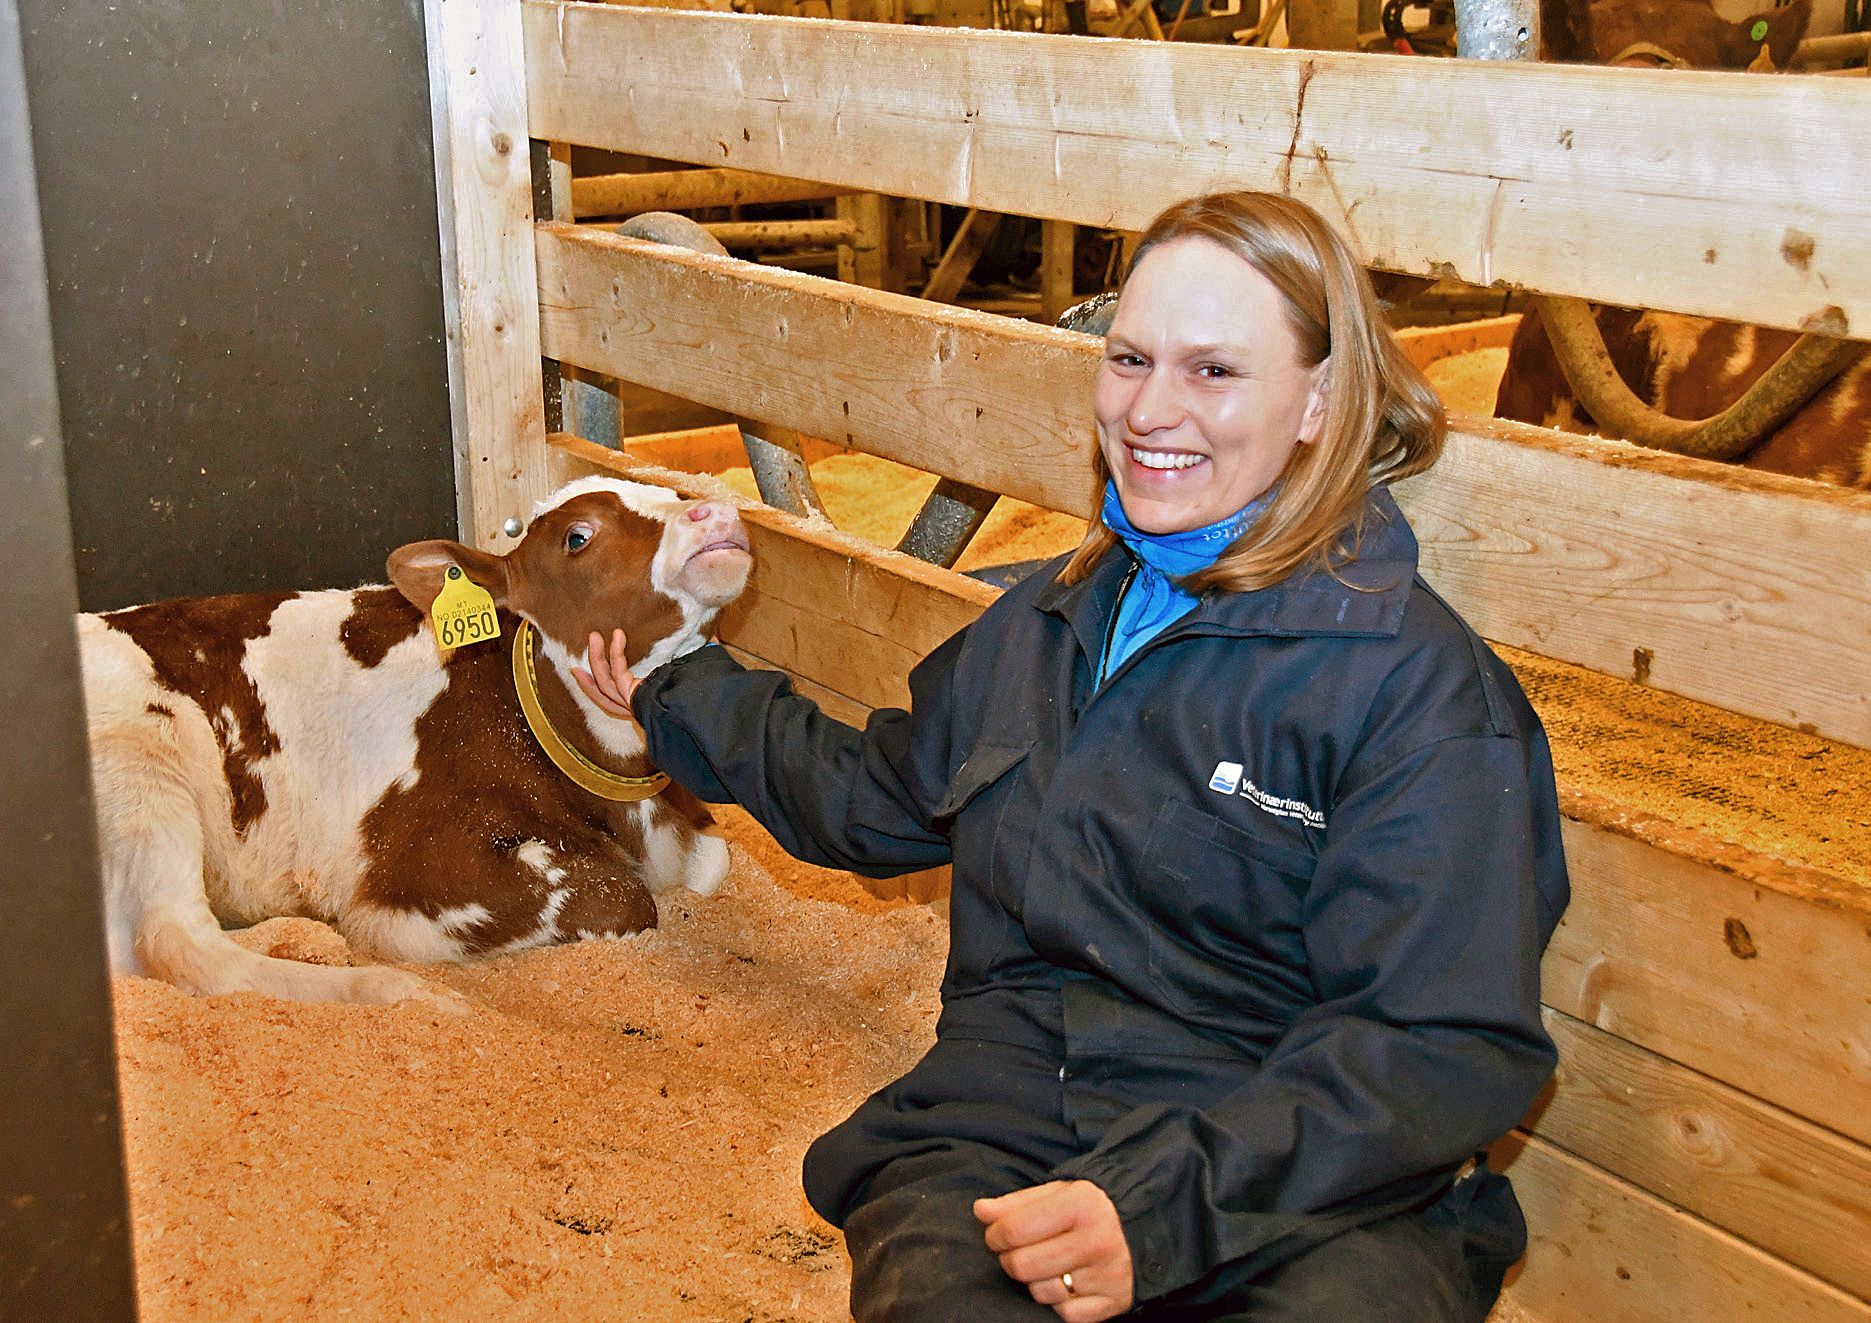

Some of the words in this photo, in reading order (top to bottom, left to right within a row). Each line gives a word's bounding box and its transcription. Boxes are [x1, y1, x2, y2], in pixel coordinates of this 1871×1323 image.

[437, 612, 450, 622] NO
[452, 603, 491, 619] 02140344
[442, 612, 495, 646] 6950
